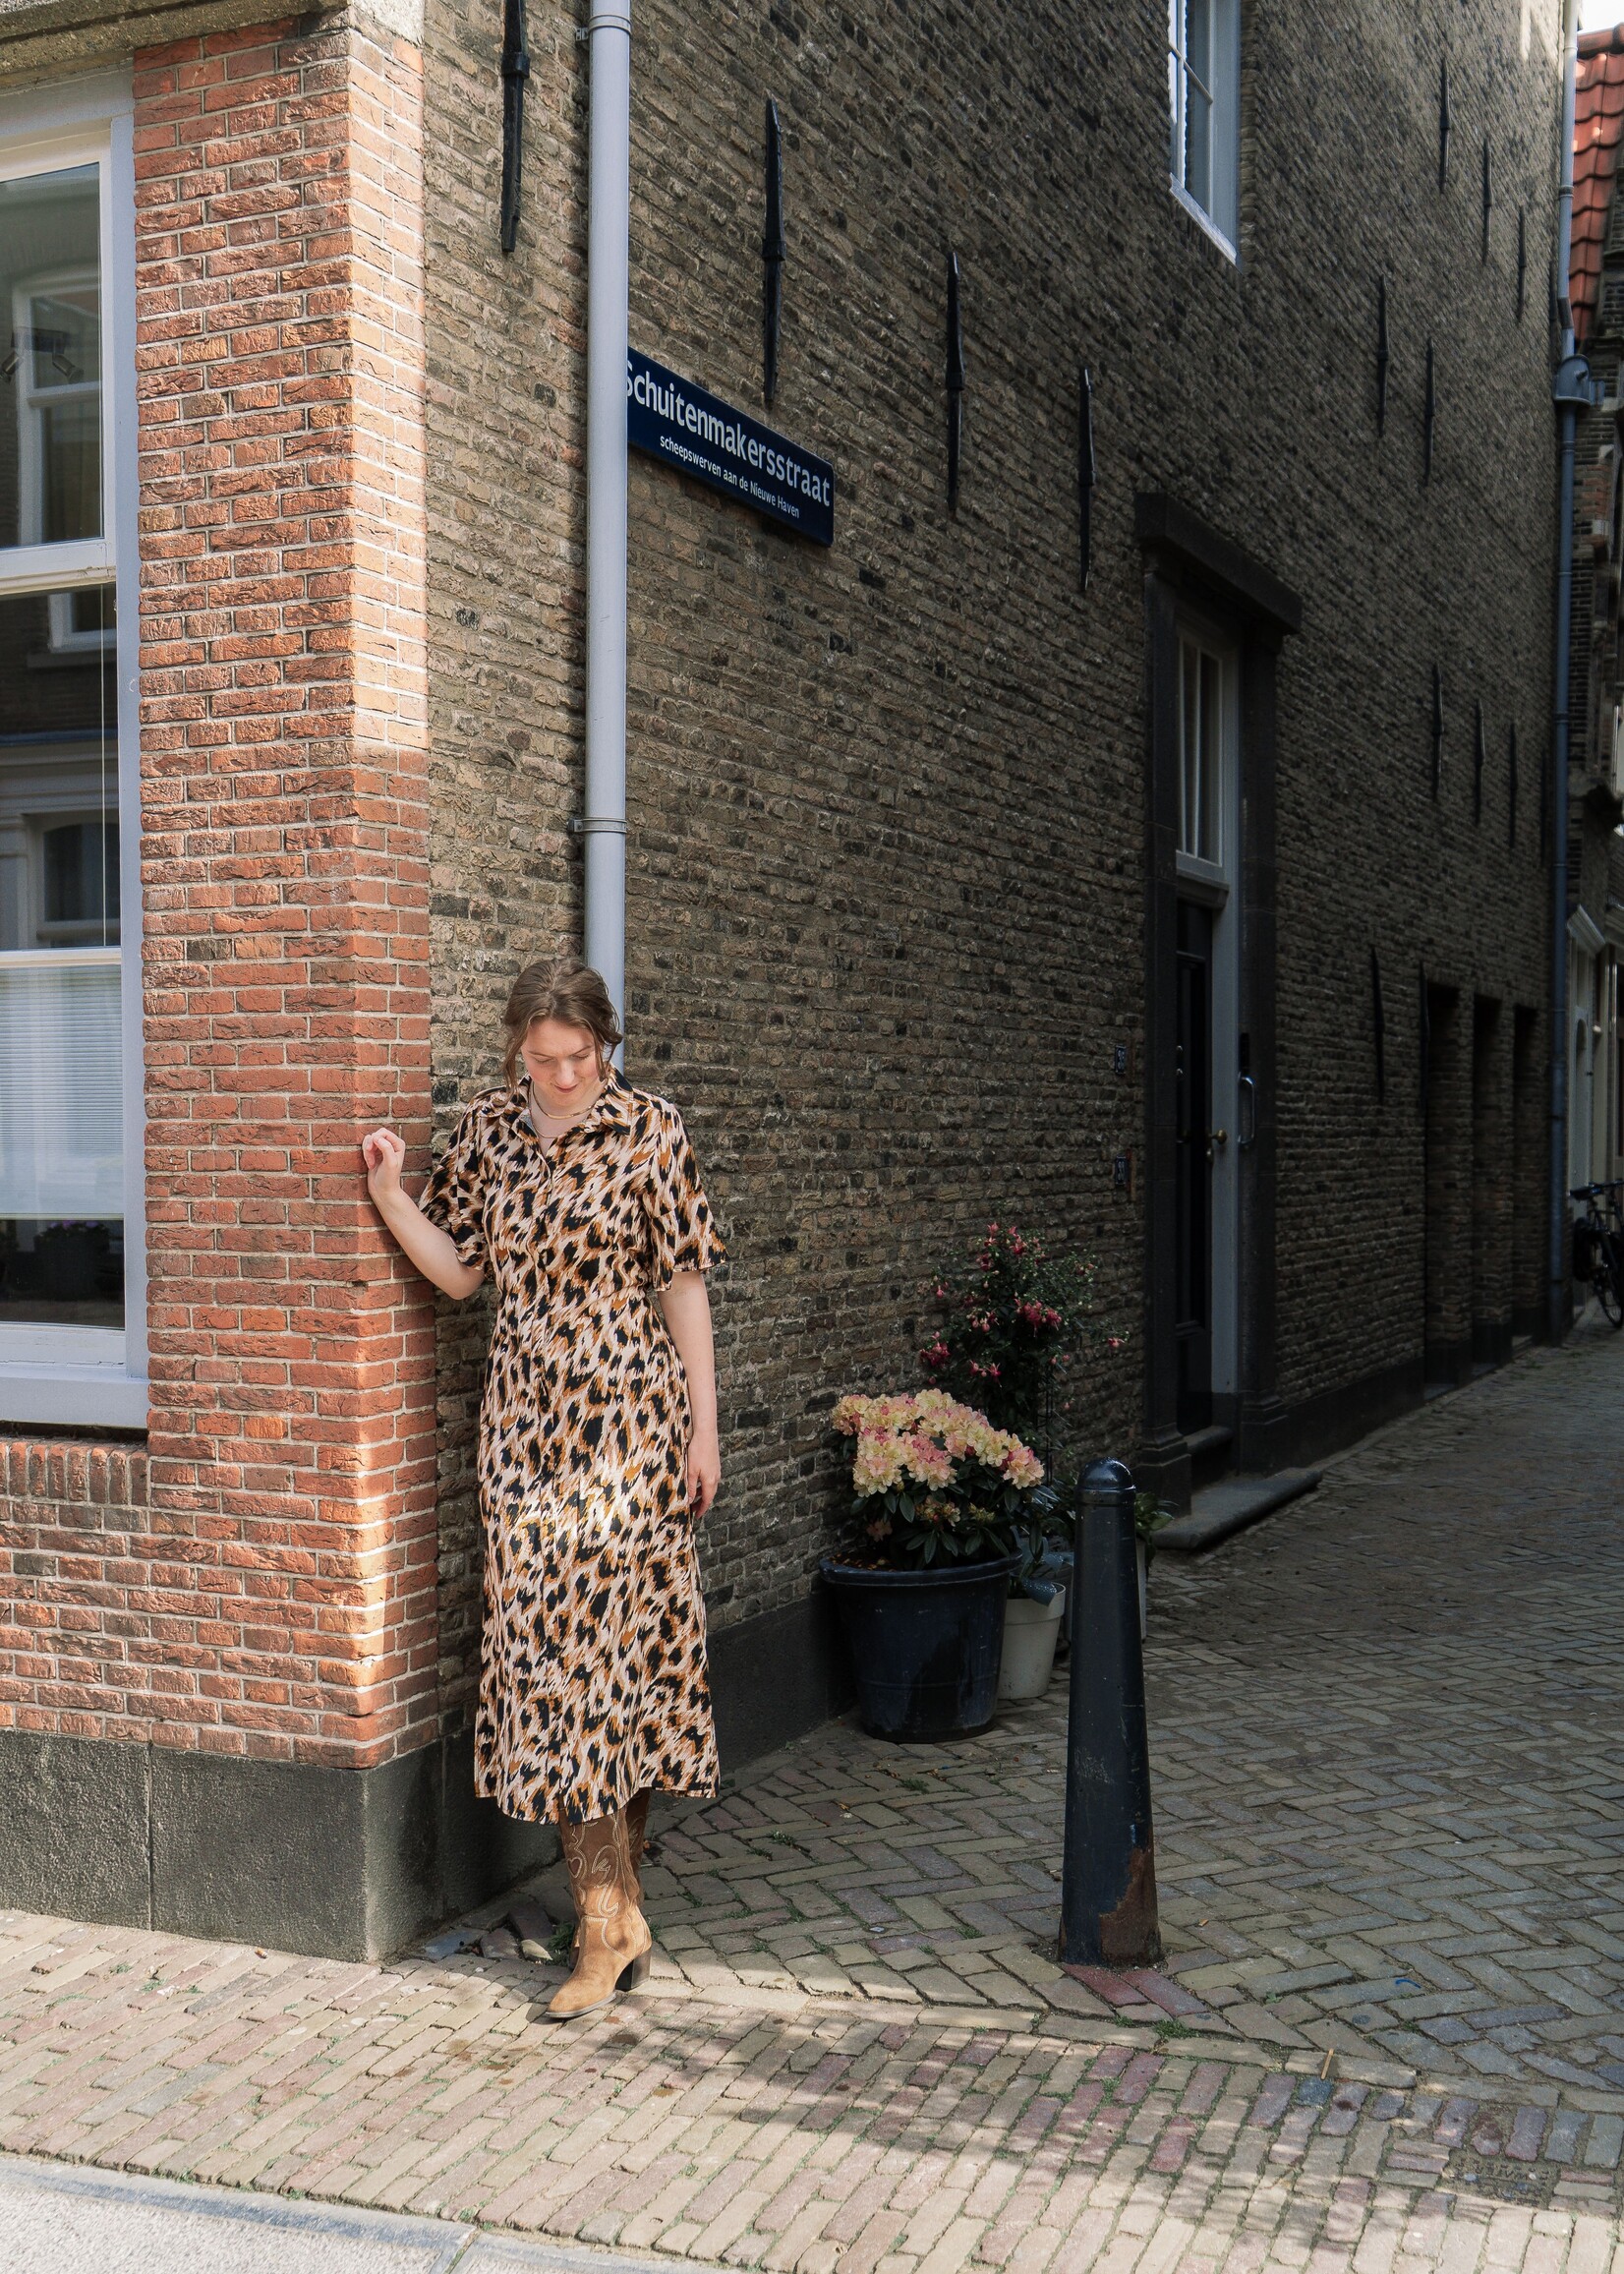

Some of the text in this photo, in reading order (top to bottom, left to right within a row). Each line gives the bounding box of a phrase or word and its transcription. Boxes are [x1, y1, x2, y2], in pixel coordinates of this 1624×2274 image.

[660, 435, 800, 519] scheepswerven aan de Nieuwe Haven
